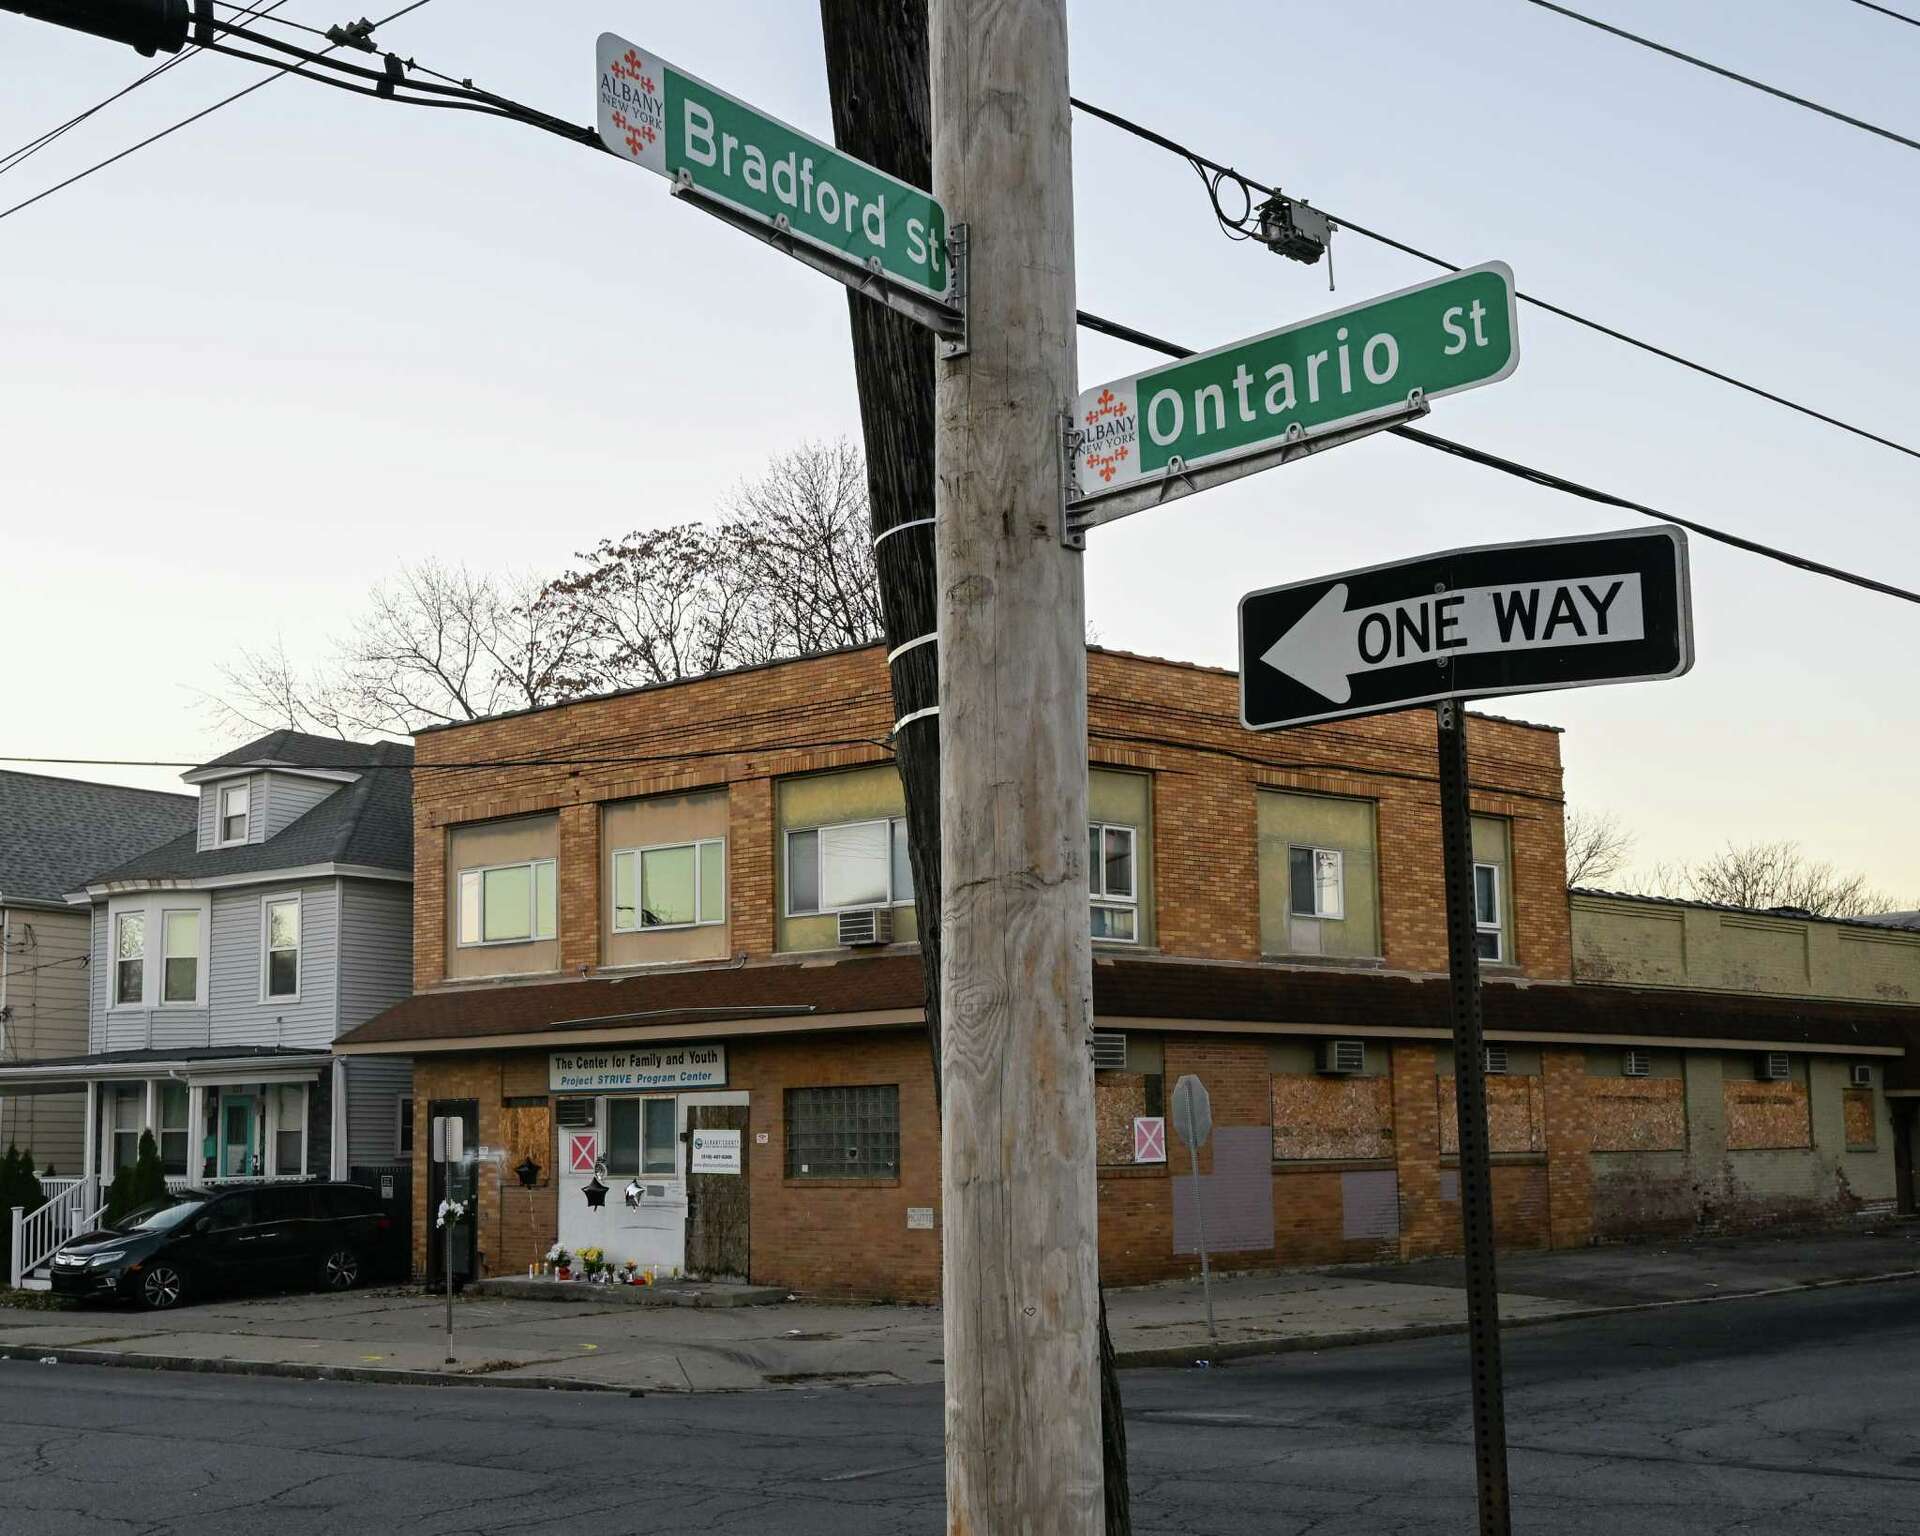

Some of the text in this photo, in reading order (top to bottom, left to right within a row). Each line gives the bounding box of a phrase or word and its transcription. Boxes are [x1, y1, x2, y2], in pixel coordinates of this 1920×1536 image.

[601, 73, 663, 116] ALBANY
[602, 92, 663, 129] NEW YORK
[684, 98, 941, 273] Bradford St
[1146, 299, 1489, 447] Ontario St
[1105, 431, 1136, 449] YORK
[1357, 581, 1625, 664] ONE WAY
[555, 1050, 718, 1070] The Center for Family and Youth
[561, 1071, 712, 1087] Project STRIVE Program Center
